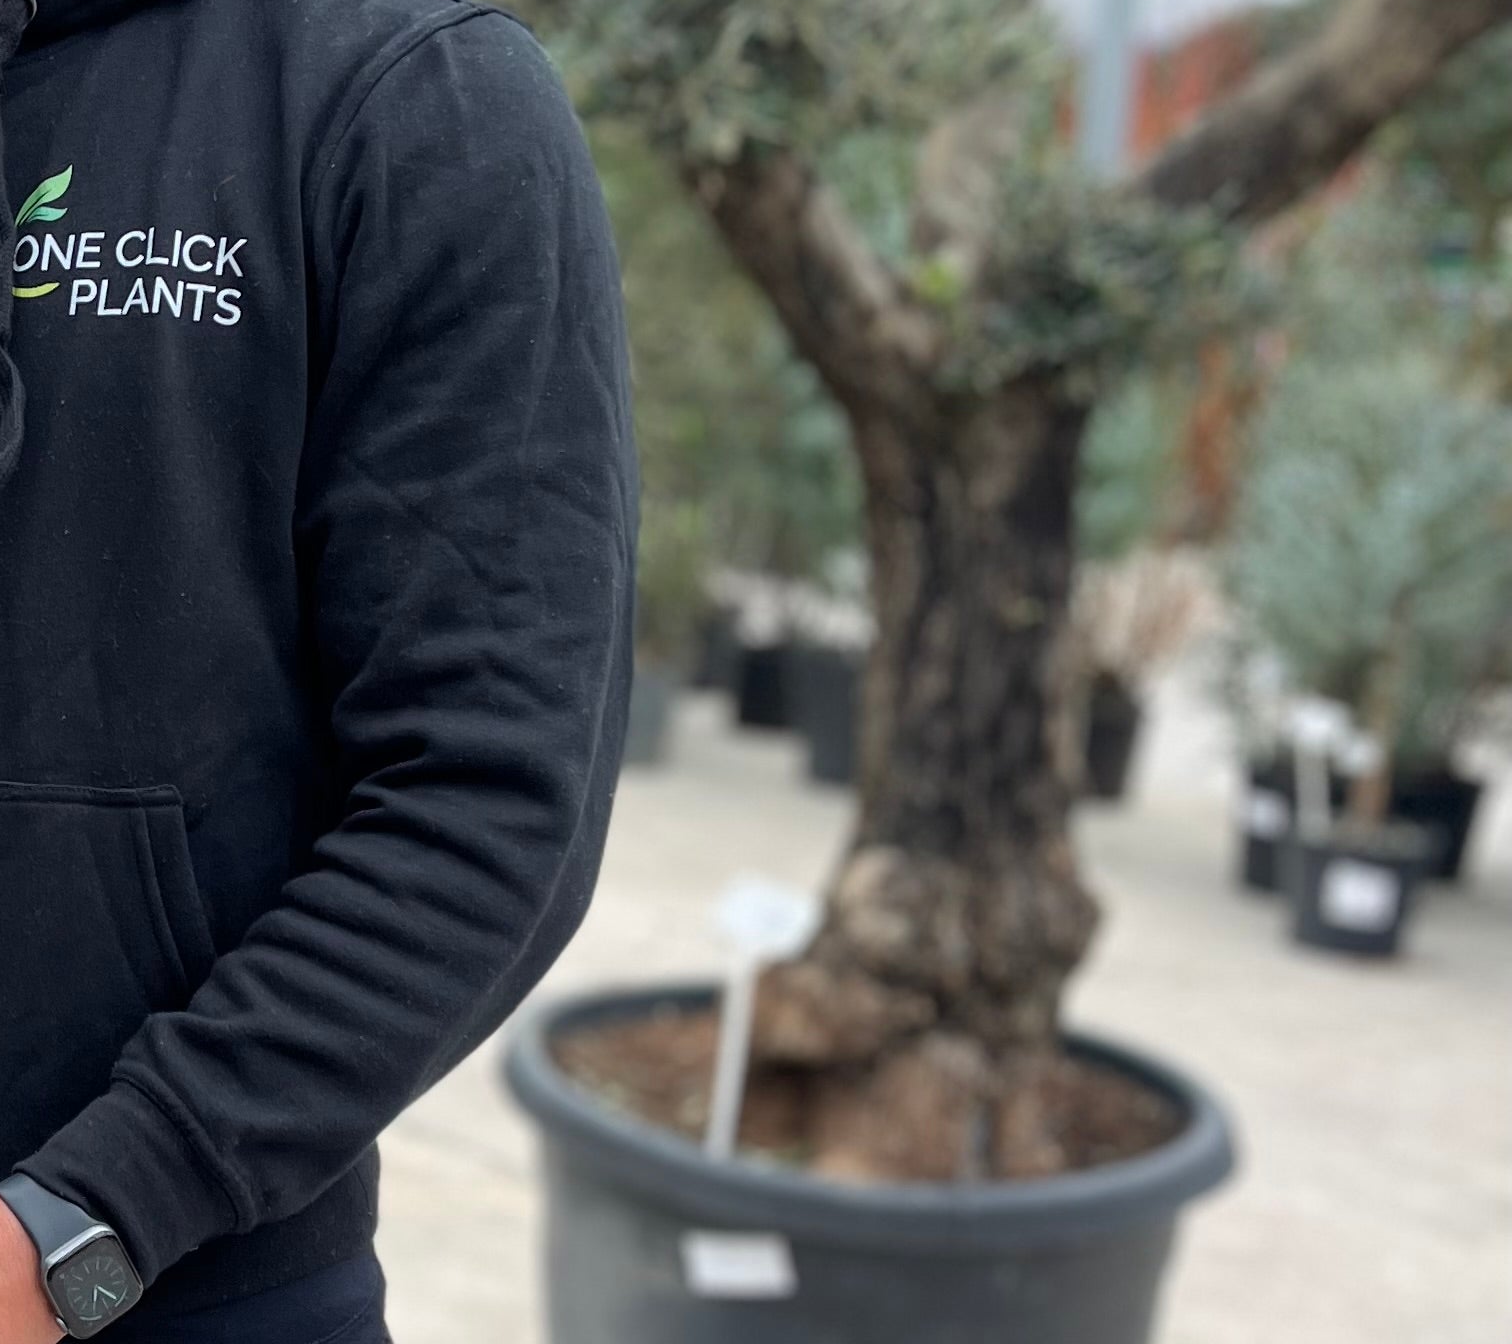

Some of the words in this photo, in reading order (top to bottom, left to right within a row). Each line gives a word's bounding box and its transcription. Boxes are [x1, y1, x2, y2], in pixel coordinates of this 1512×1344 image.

[12, 231, 106, 273] ONE
[115, 226, 248, 278] CLICK
[68, 275, 242, 327] PLANTS
